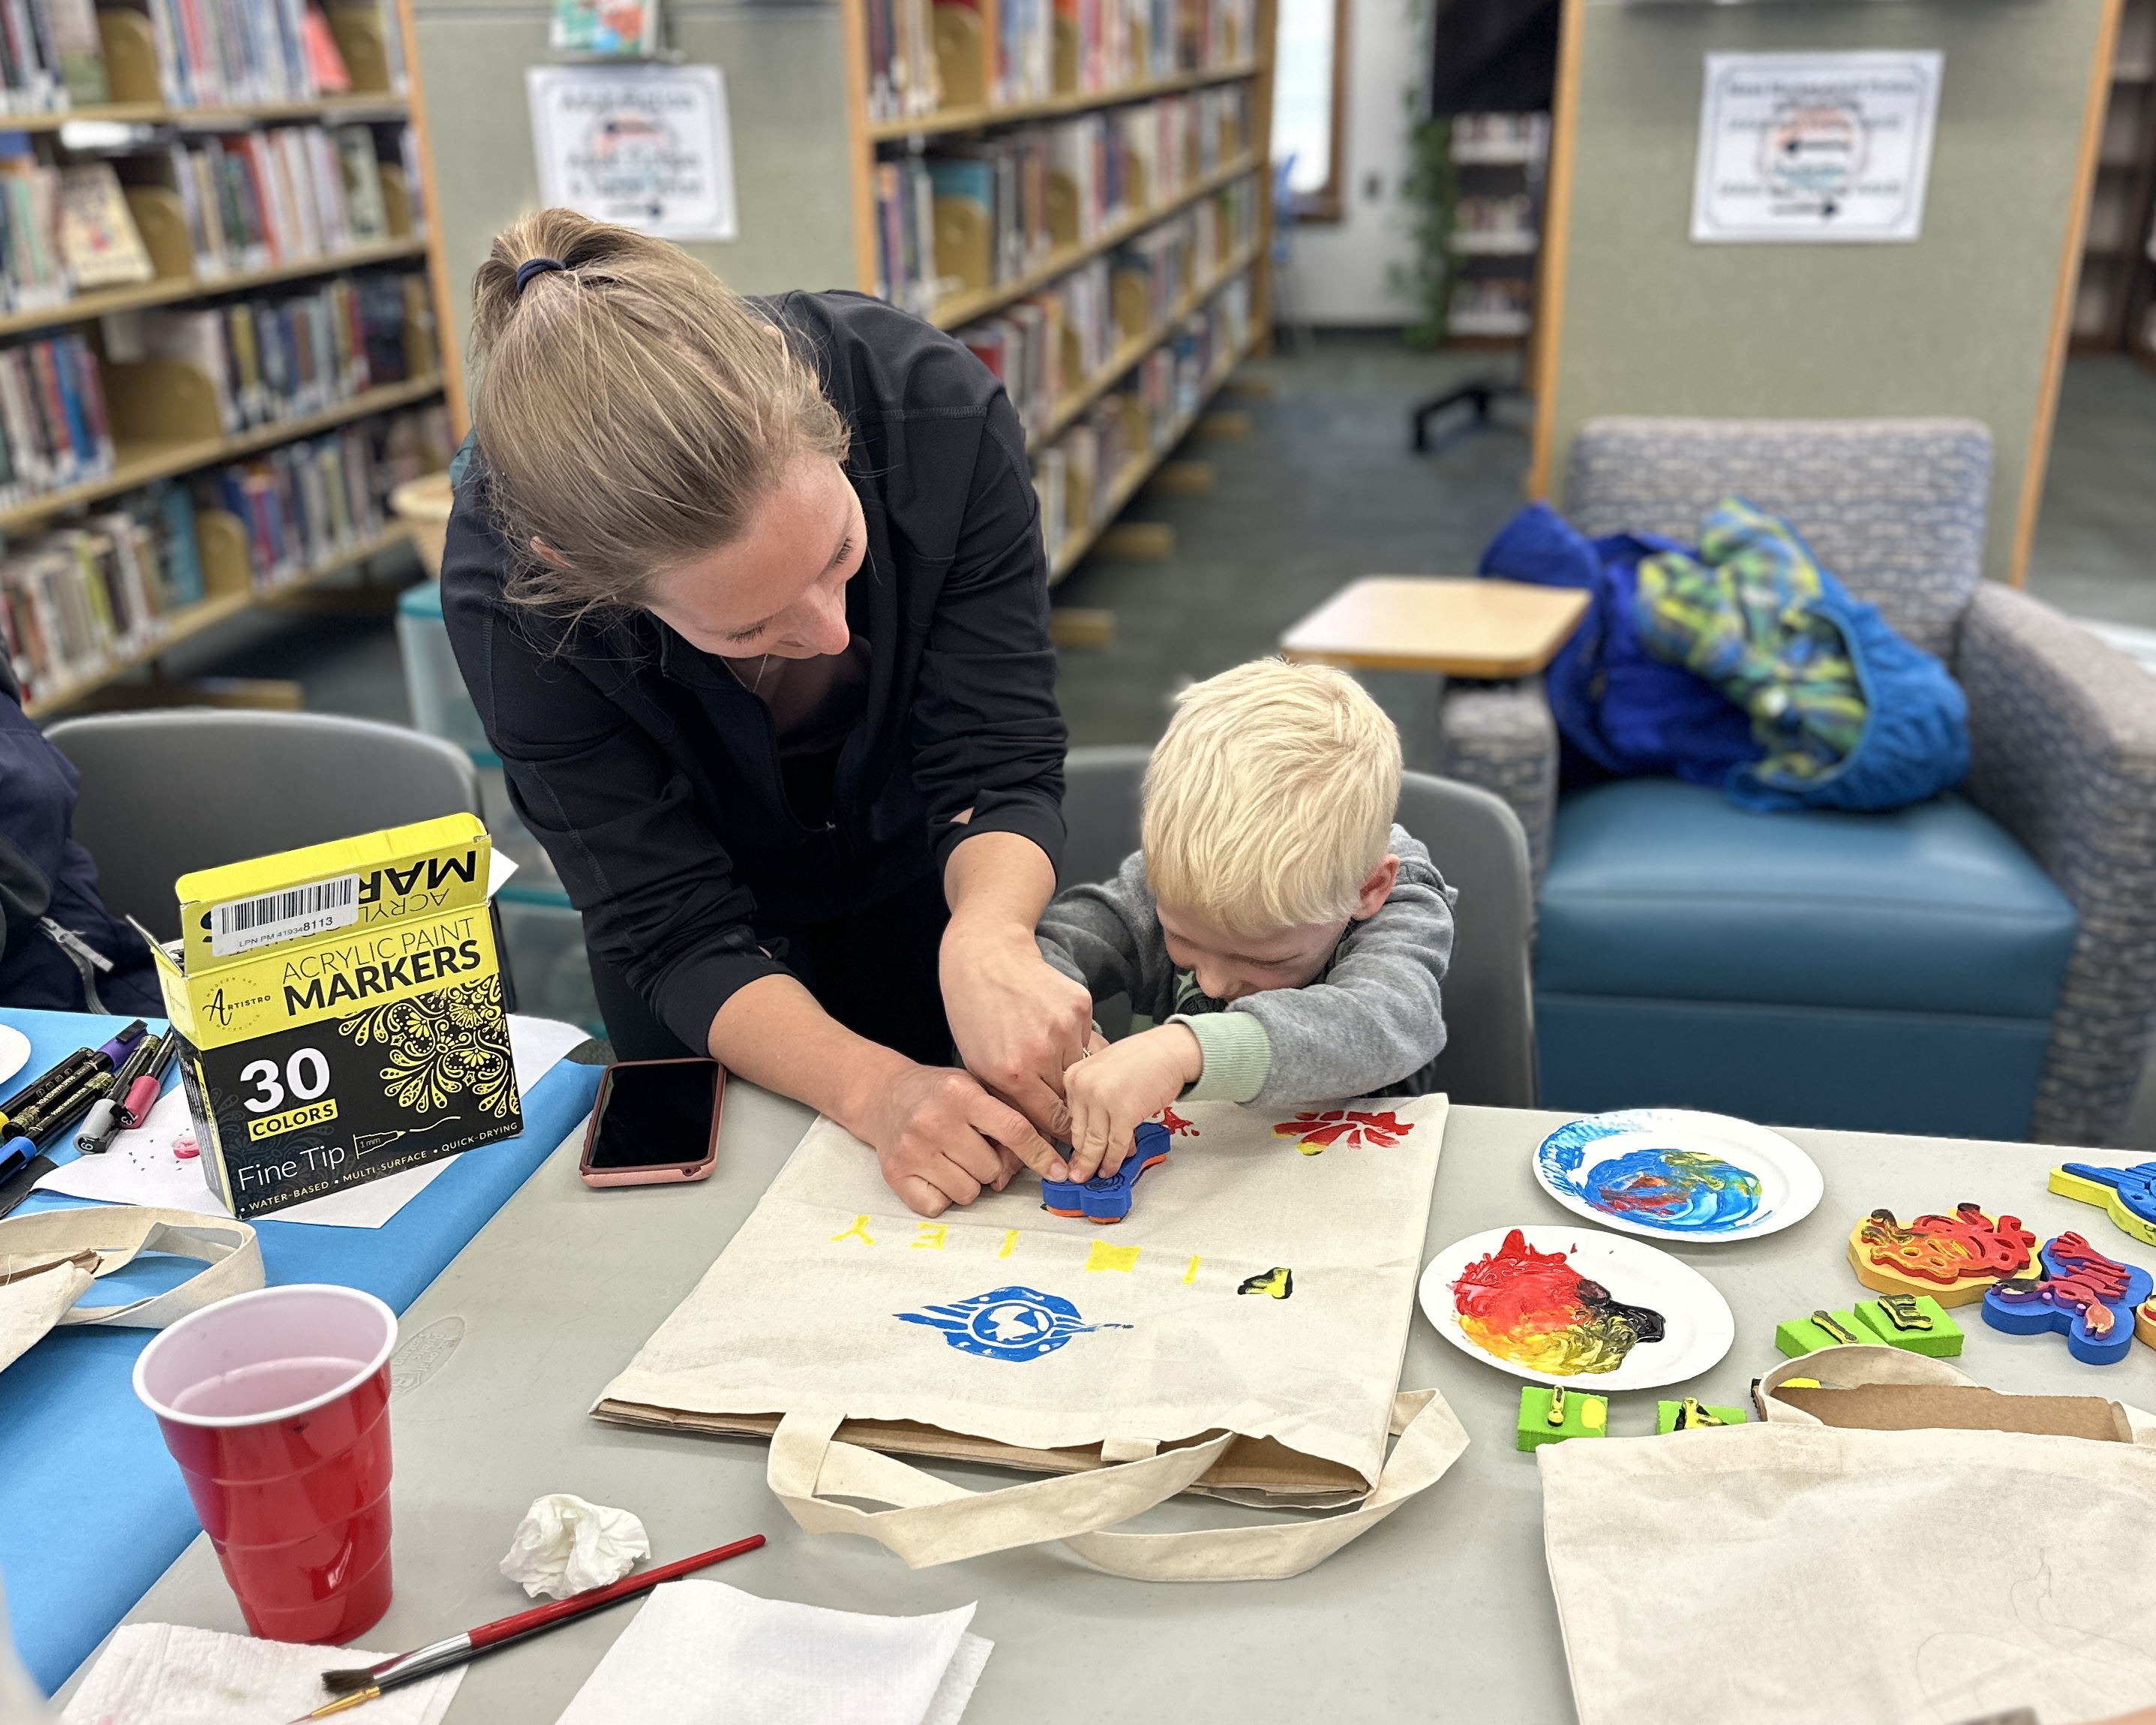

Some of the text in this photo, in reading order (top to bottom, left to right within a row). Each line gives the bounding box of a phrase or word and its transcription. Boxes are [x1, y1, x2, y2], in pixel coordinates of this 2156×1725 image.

[239, 938, 258, 947] LPN
[260, 933, 275, 942] PM
[283, 937, 396, 984] ACRYLIC
[401, 917, 474, 954] PAINT
[284, 939, 481, 1016] MARKERS
[240, 1047, 330, 1113] 30
[121, 1110, 139, 1125] 73
[252, 1104, 334, 1136] COLORS
[238, 1145, 345, 1191] Fine Tip
[249, 1122, 518, 1210] WATER-BASED MULTI-SURFACE QUICK-DRYING
